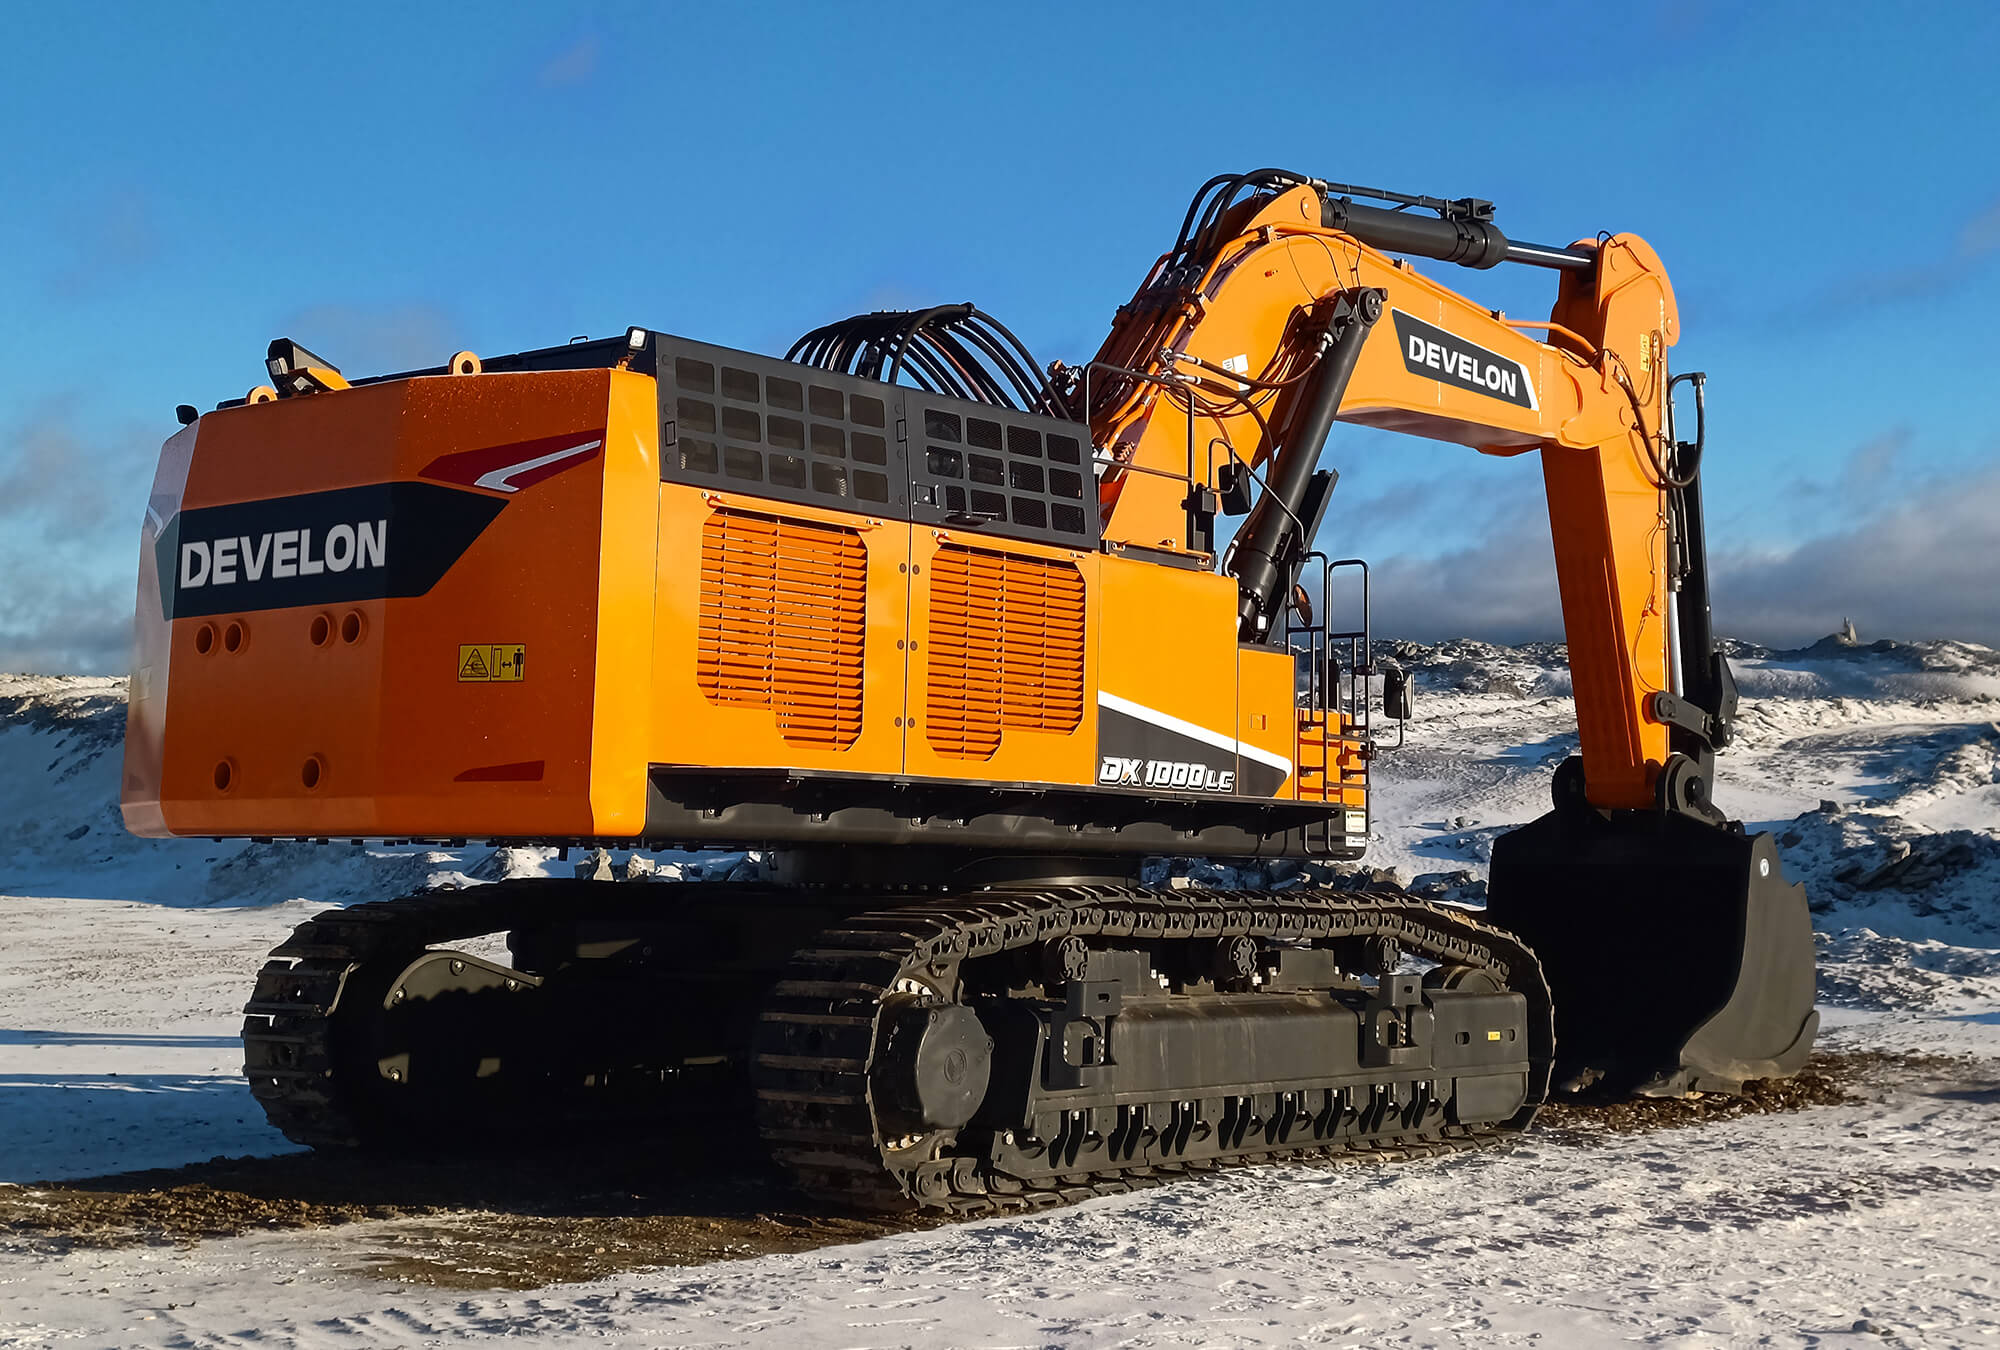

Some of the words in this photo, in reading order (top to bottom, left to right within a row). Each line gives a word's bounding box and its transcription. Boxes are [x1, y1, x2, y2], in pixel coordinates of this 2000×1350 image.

[1408, 334, 1517, 398] DEVELON
[180, 519, 388, 589] DEVELON
[1099, 756, 1143, 786] DX
